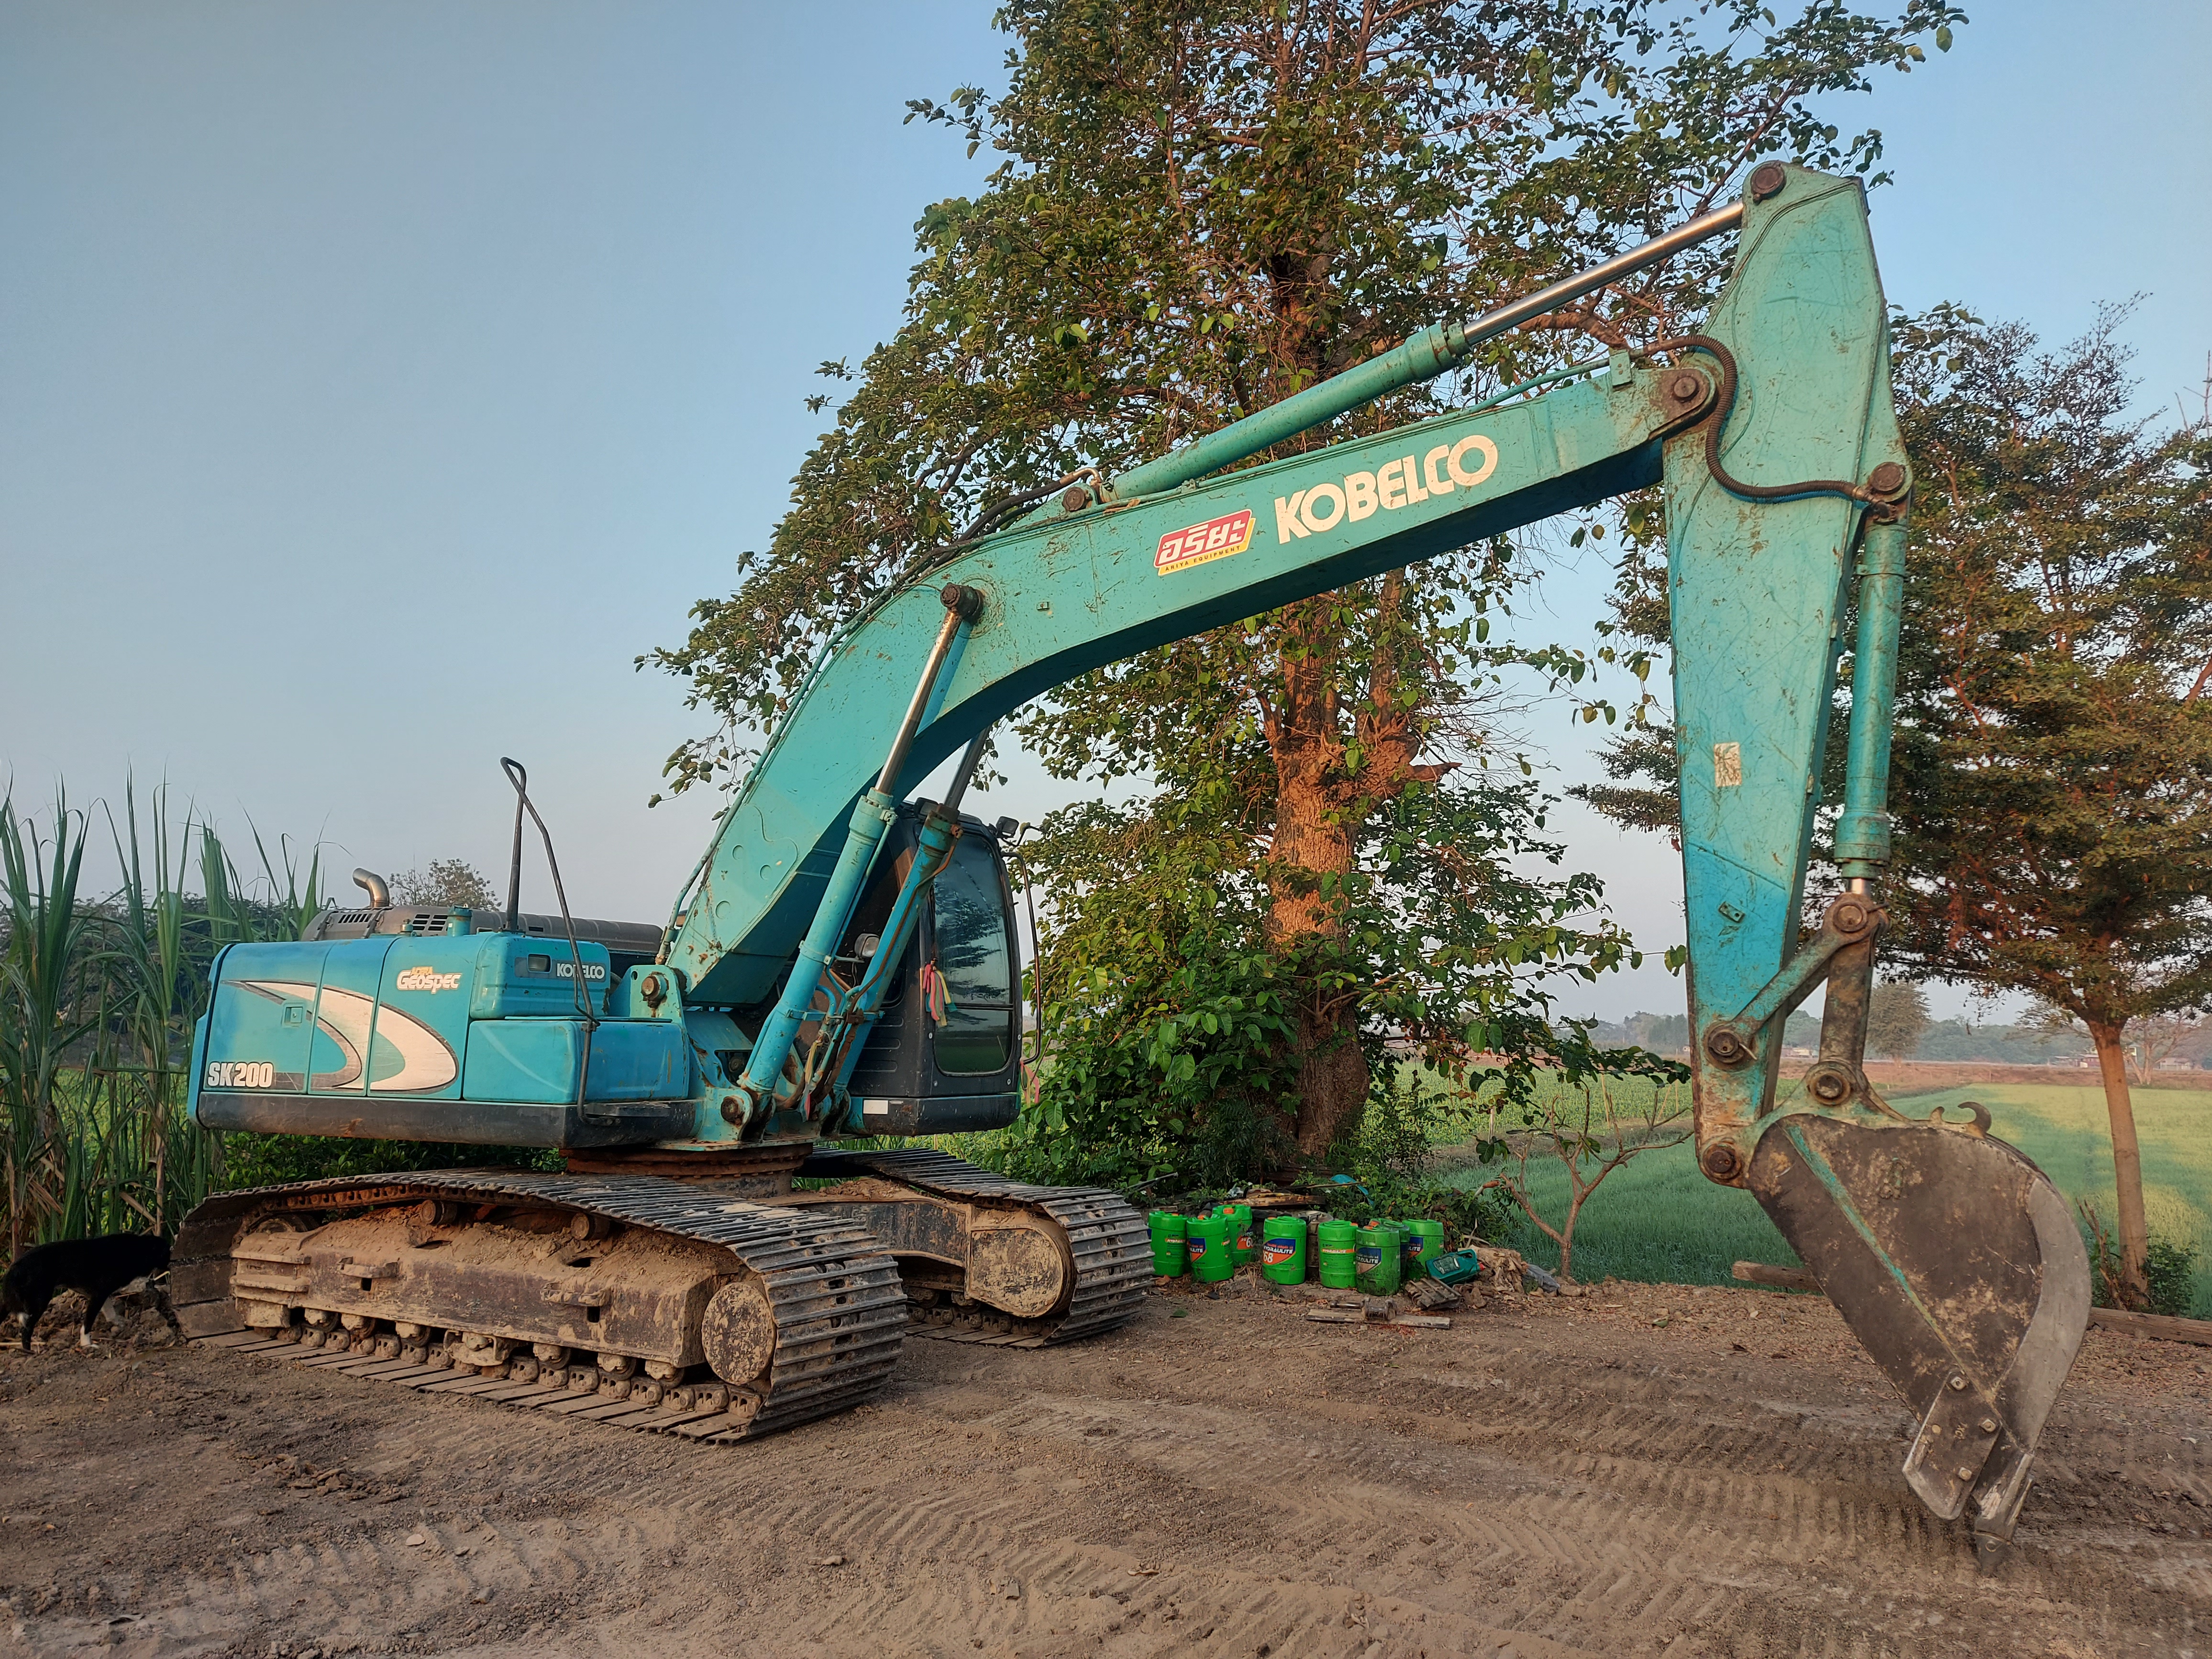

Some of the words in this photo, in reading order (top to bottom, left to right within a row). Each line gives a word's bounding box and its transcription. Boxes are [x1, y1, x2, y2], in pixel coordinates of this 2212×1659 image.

[1274, 435, 1498, 544] KOBELCO
[1165, 561, 1189, 571] ARIYA
[1194, 546, 1240, 563] EQUIPMENT
